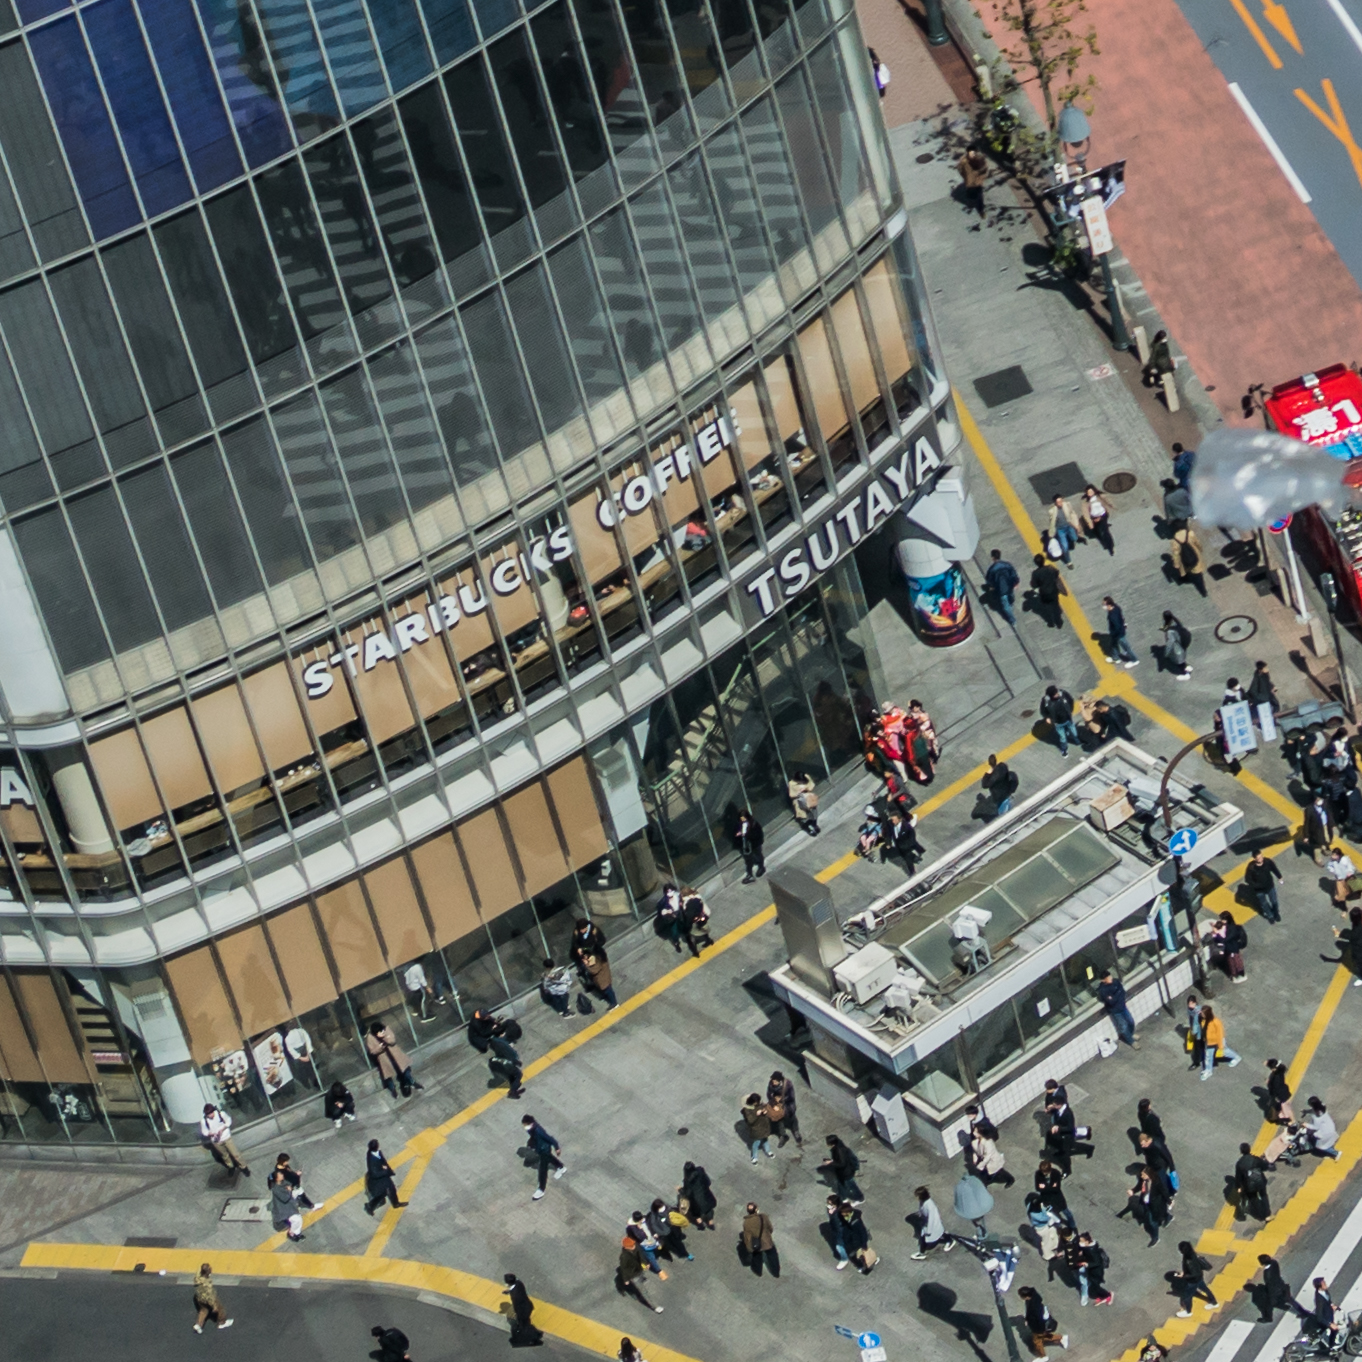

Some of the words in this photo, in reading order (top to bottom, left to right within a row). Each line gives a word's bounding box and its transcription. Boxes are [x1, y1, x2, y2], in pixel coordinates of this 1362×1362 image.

[303, 525, 574, 697] STARBUCKS
[598, 407, 742, 528] COFFEE
[747, 436, 941, 615] TSUTAYA
